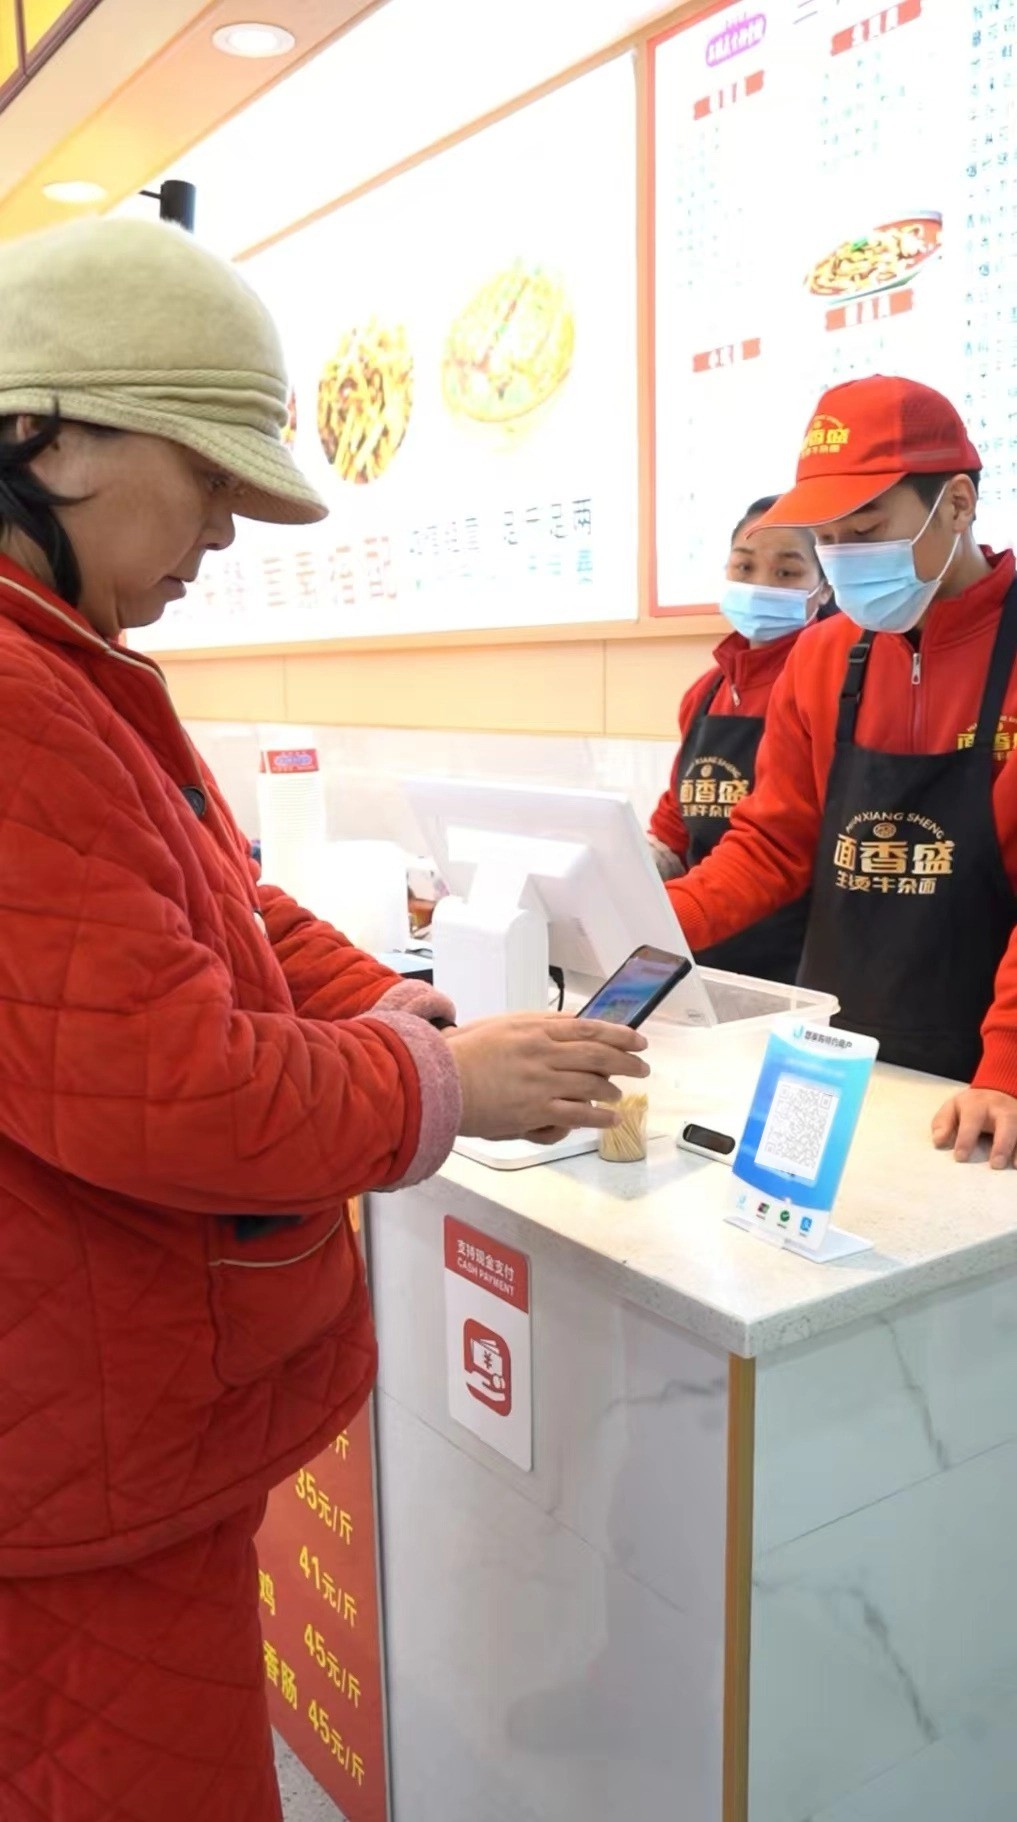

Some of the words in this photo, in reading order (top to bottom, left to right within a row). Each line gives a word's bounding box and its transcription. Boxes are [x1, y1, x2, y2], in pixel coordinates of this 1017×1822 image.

[833, 833, 955, 875] 面香盛
[907, 812, 945, 839] SHENG
[835, 870, 938, 894] 生烫牛杂面
[457, 1239, 515, 1282] 支持现金支付
[457, 1256, 478, 1278] CASH
[479, 1269, 514, 1297] PAYMENT
[295, 1467, 353, 1546] 35元/斤
[299, 1545, 358, 1628] 41元/斤
[263, 1639, 298, 1711] 香肠
[304, 1623, 362, 1708] 45元/斤
[308, 1699, 365, 1786] 45元/斤
